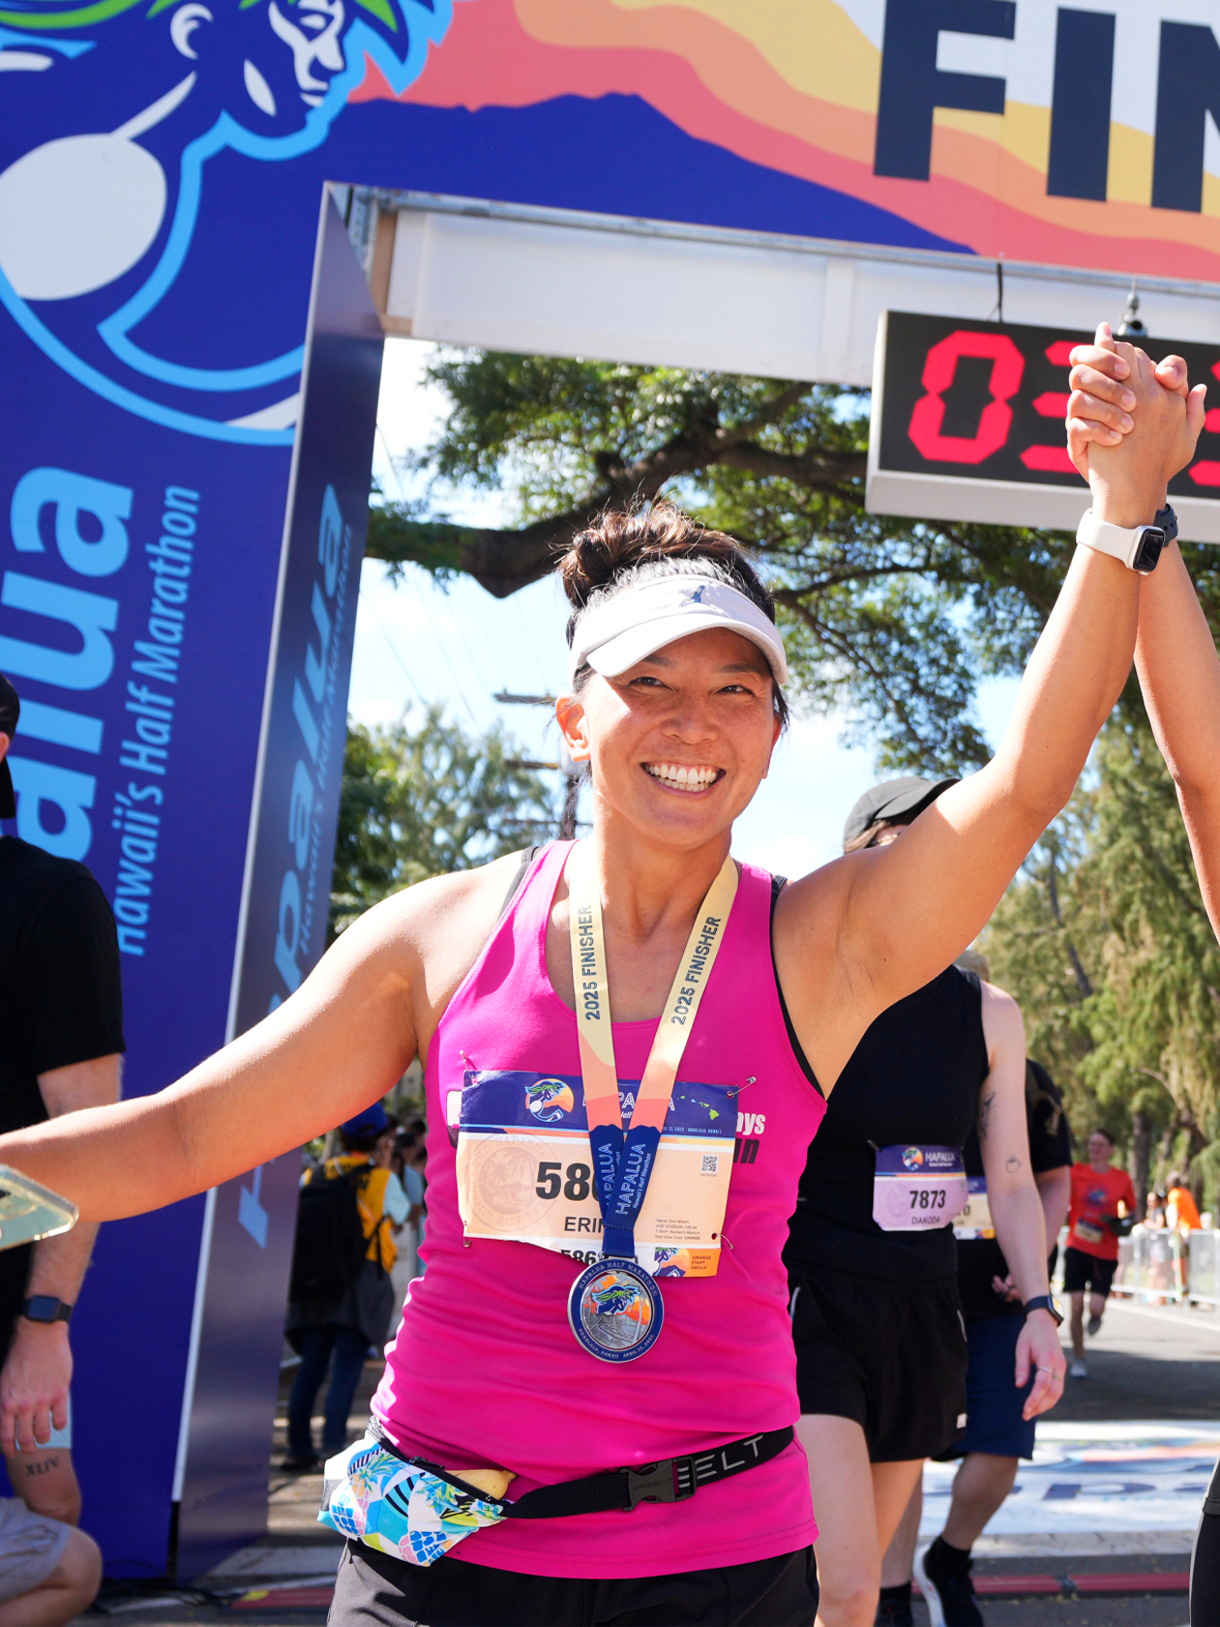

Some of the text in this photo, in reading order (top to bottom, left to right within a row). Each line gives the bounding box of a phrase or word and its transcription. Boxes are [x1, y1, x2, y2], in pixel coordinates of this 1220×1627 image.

[111, 485, 201, 957] Hawaii's Half Marathon
[578, 905, 600, 1021] 2025 FINISHER
[671, 916, 721, 1025] 2025 FINISHER
[535, 1161, 600, 1202] 58
[615, 1143, 646, 1215] HAPALUA
[909, 1189, 947, 1210] 7873
[25, 1456, 59, 1477] XLIV
